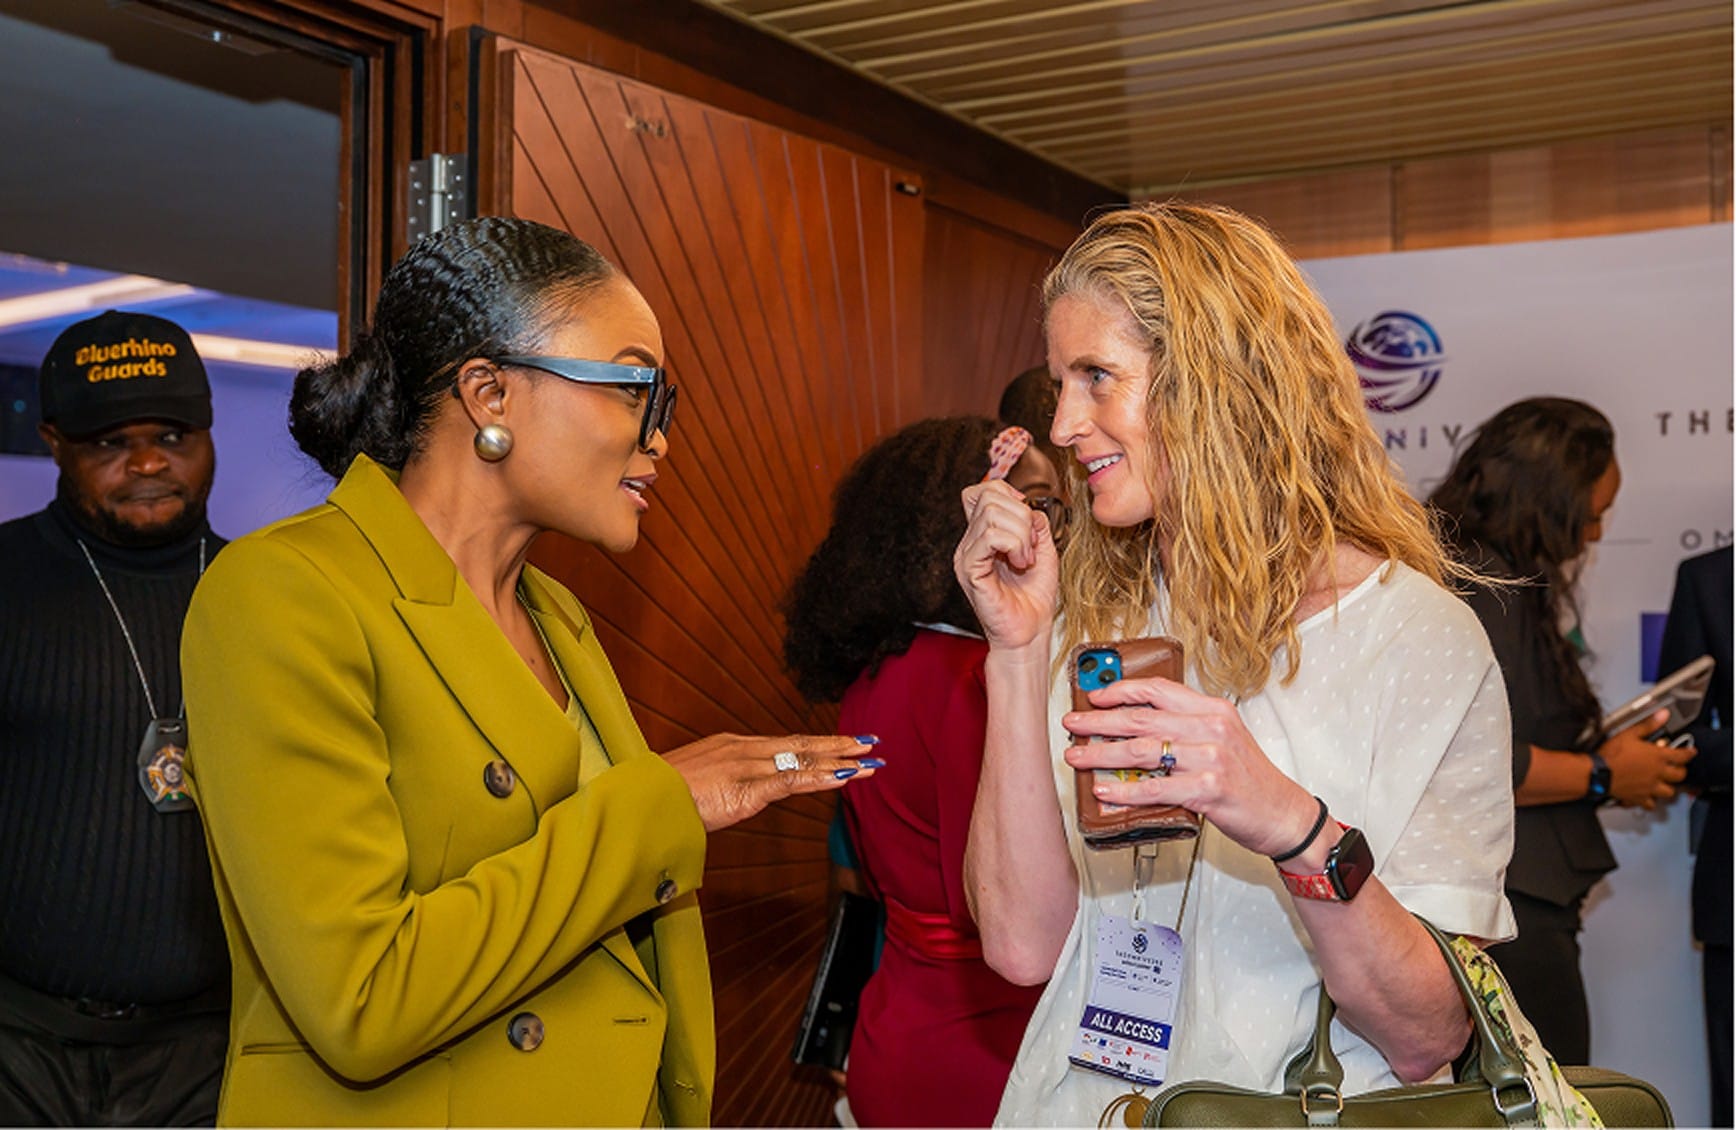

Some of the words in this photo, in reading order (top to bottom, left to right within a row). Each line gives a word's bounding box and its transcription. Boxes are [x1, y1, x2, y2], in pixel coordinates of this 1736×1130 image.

[75, 338, 177, 366] Bluerhino
[87, 358, 167, 383] Guards
[1090, 1012, 1113, 1031] ALL
[1114, 1018, 1163, 1043] ACCESS
